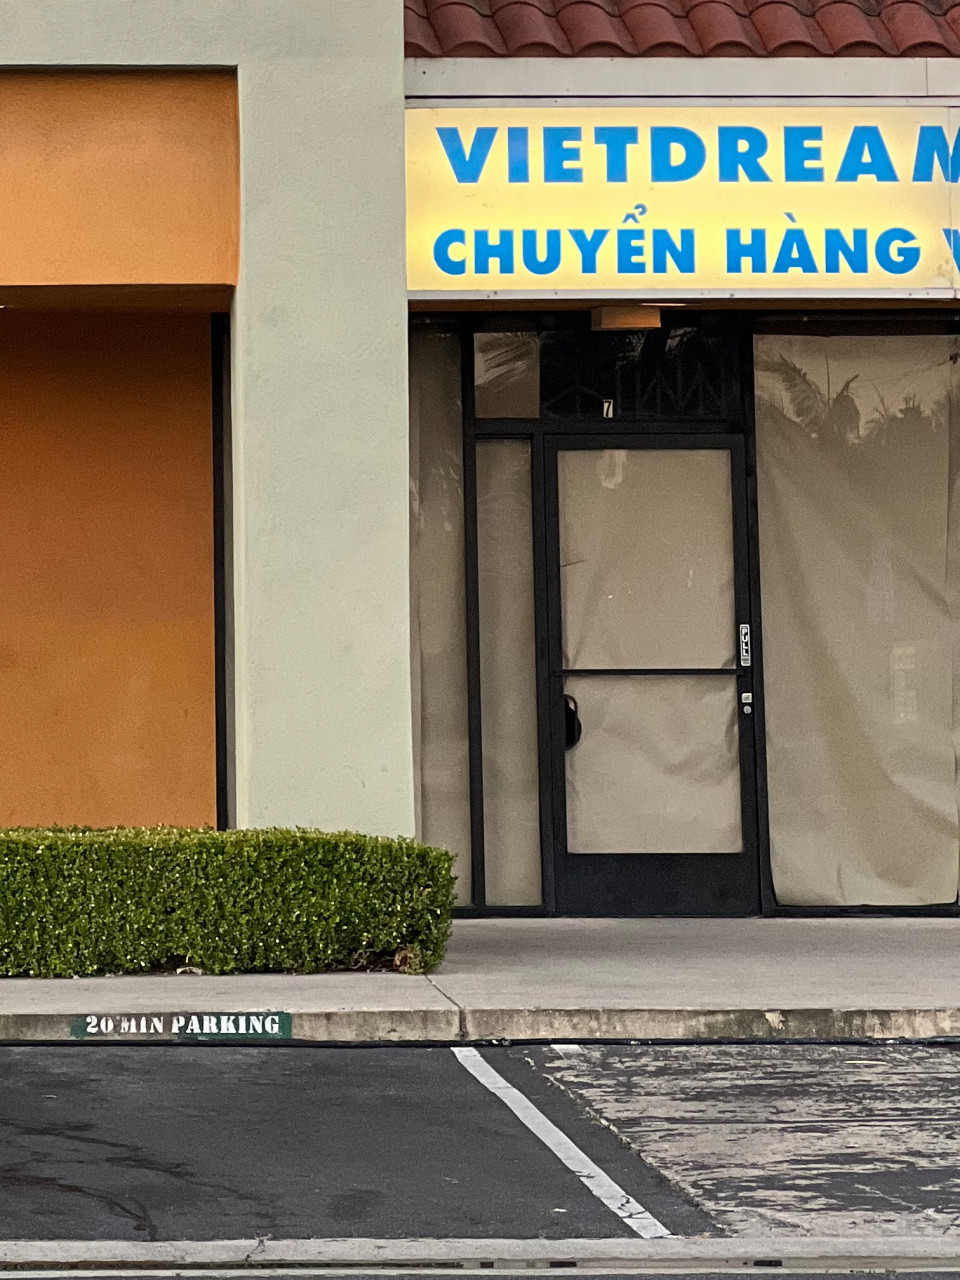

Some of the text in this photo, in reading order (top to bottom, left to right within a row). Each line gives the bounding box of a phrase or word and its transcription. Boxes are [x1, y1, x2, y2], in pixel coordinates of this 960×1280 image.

[436, 126, 960, 183] VIETDREAM
[433, 204, 695, 276] CHUYỂN
[726, 212, 921, 275] HÀNG
[604, 400, 612, 418] 7
[86, 1015, 280, 1034] 20 MIN PARKING
